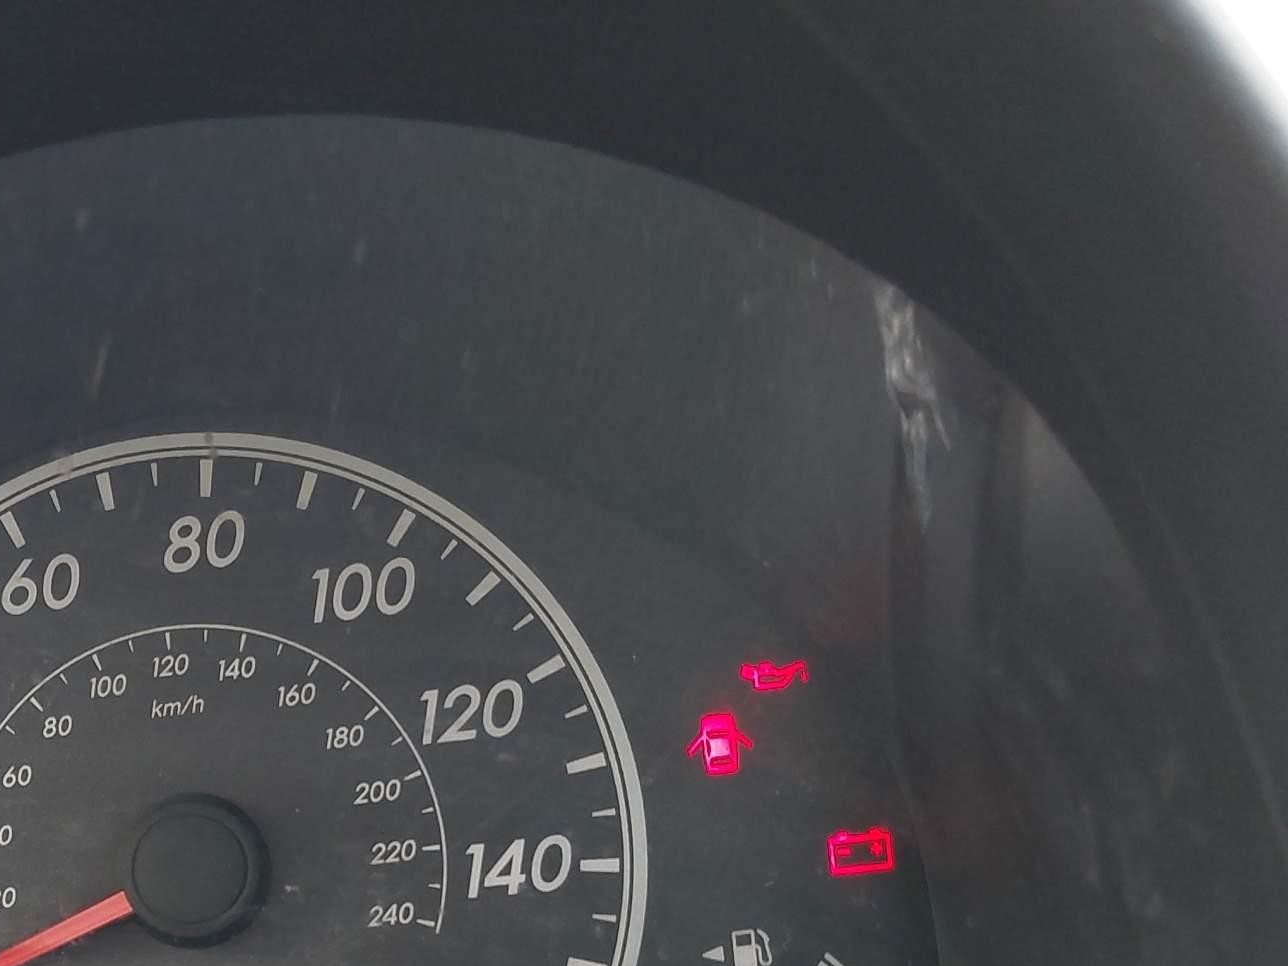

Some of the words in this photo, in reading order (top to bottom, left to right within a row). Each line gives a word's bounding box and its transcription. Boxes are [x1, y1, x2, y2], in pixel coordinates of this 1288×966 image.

[163, 510, 245, 573] 80
[1, 553, 80, 615] 60
[312, 557, 416, 623] 100
[152, 653, 190, 679] 120
[218, 656, 256, 681] 140
[89, 674, 127, 699] 100
[278, 683, 316, 708] 160
[151, 694, 204, 719] km/h
[420, 679, 524, 745] 120
[42, 715, 73, 738] 80
[325, 725, 365, 750] 180
[2, 764, 32, 788] 60
[353, 779, 402, 806] 200
[369, 838, 417, 866] 220
[465, 834, 573, 899] 140
[367, 902, 414, 928] 240
